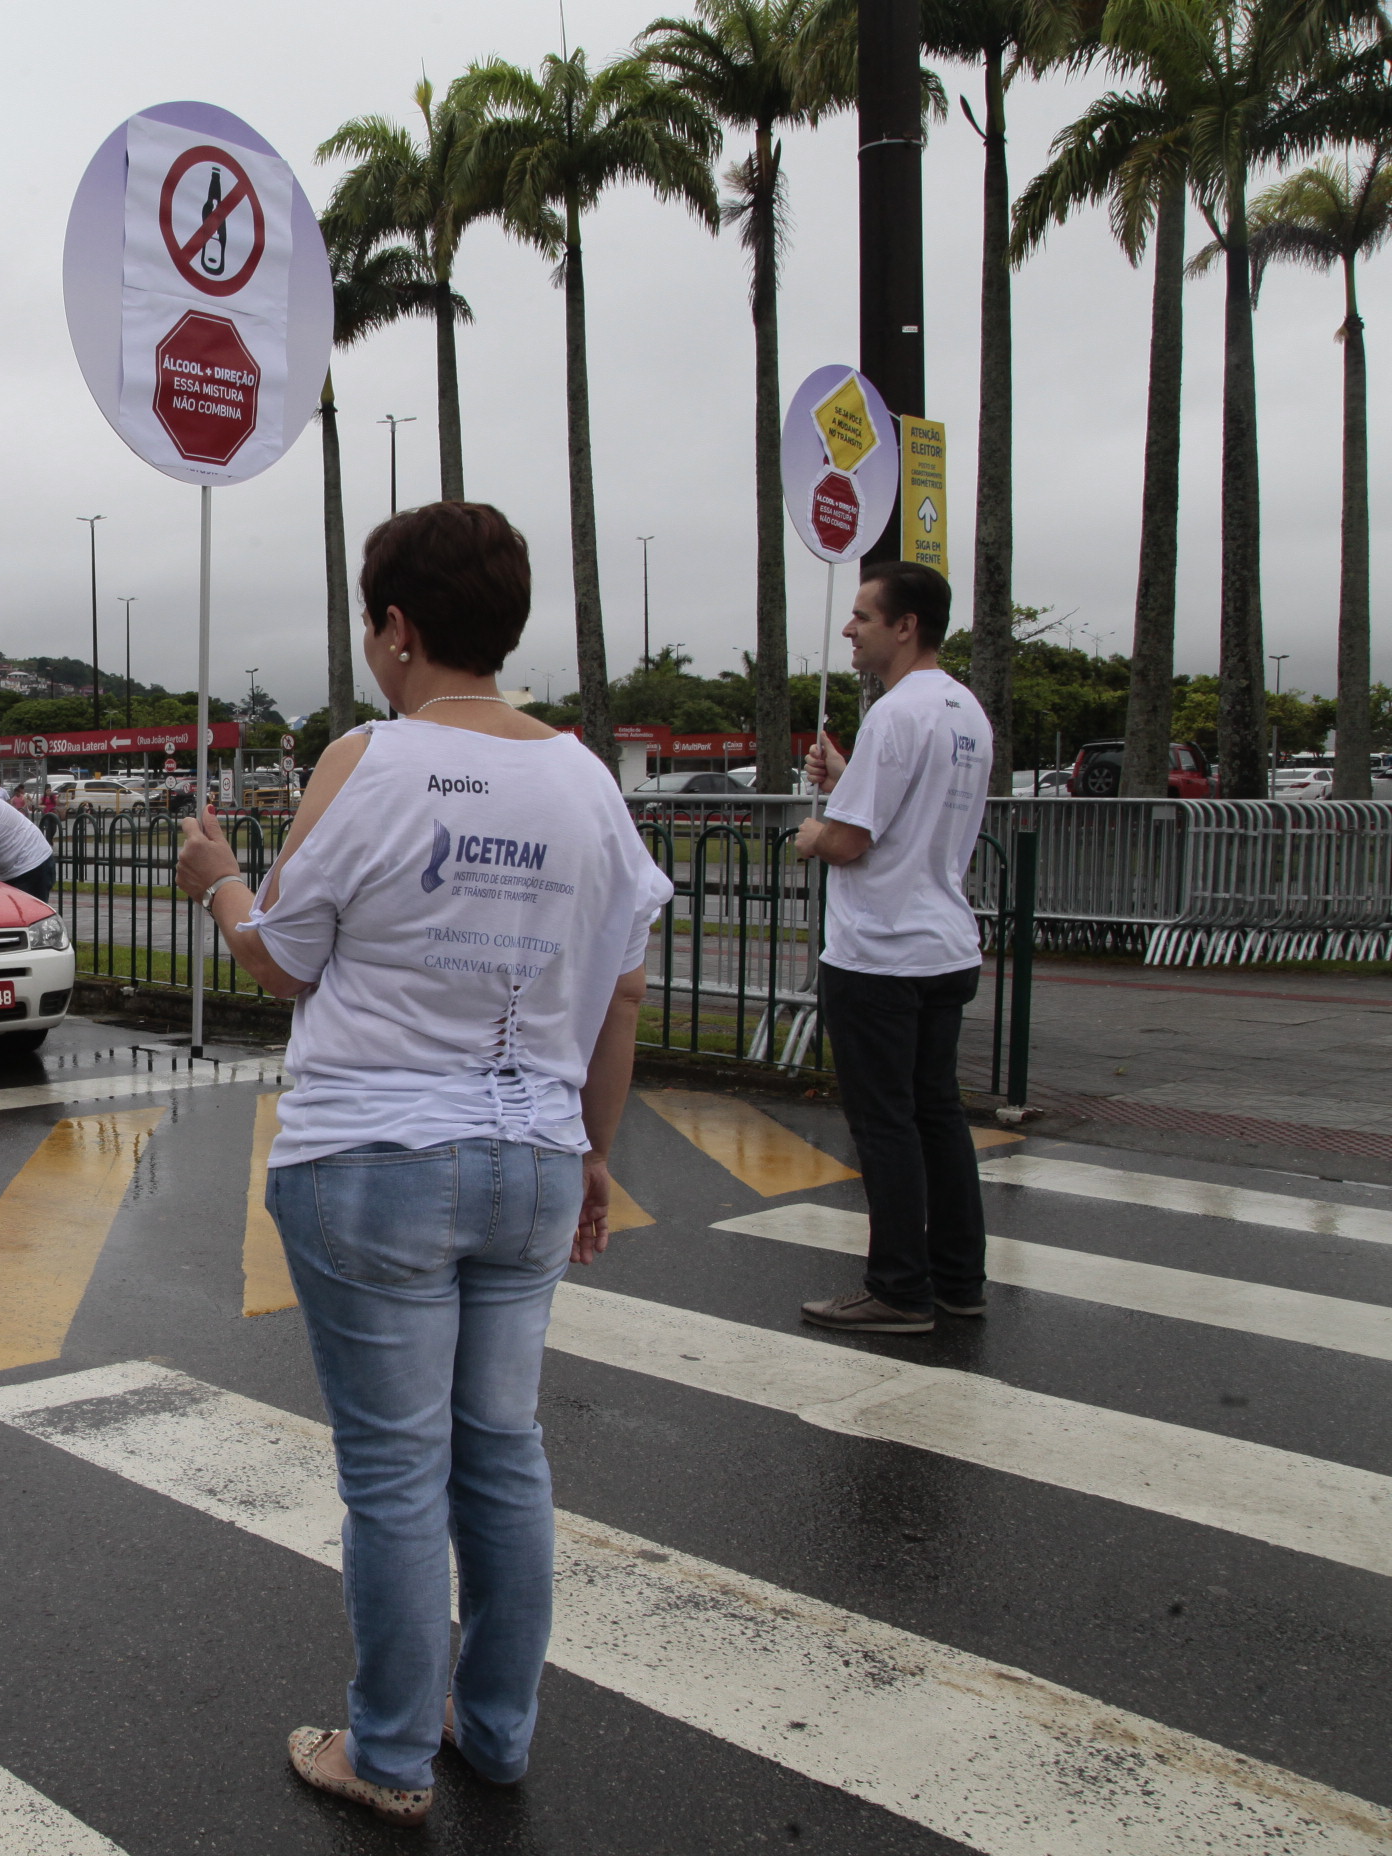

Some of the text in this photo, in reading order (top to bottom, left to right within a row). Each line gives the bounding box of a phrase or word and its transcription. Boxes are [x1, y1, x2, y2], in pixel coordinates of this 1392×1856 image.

[163, 354, 203, 376] ÁLCOOL
[214, 366, 255, 387] DIREÇÃO
[173, 377, 244, 403] ESSA MISTURA
[172, 395, 242, 420] NÃO COMBINA
[834, 406, 848, 418] SEJA
[832, 417, 862, 438] A MUDANÇA
[911, 427, 942, 442] ATENÇÃO,
[828, 427, 863, 450] NO TRÂNSITO
[911, 442, 943, 458] ELEITOR!
[911, 477, 943, 490] BIOMÉTRICO
[816, 493, 835, 506] ÁLCOOL
[819, 505, 852, 522] ESSA MISTURA
[819, 515, 851, 531] NÃO COMBINA
[915, 540, 941, 552] SIGA EM
[916, 552, 941, 565] FRENTE
[67, 742, 81, 752] Rua
[81, 739, 108, 751] Lateral
[137, 735, 150, 746] (Rua
[151, 734, 166, 745] João
[427, 774, 489, 797] Apoio:
[455, 835, 548, 871] ICETRAN
[453, 871, 490, 884] INSTITUTO
[490, 874, 500, 885] DE
[538, 880, 545, 890] E
[545, 881, 575, 895] ESTUDOS
[451, 886, 462, 896] DE
[463, 885, 497, 899] TRÂNSITO
[497, 889, 503, 900] E
[425, 926, 490, 946] TRÂNSITO
[424, 955, 494, 975] CARNAVAL
